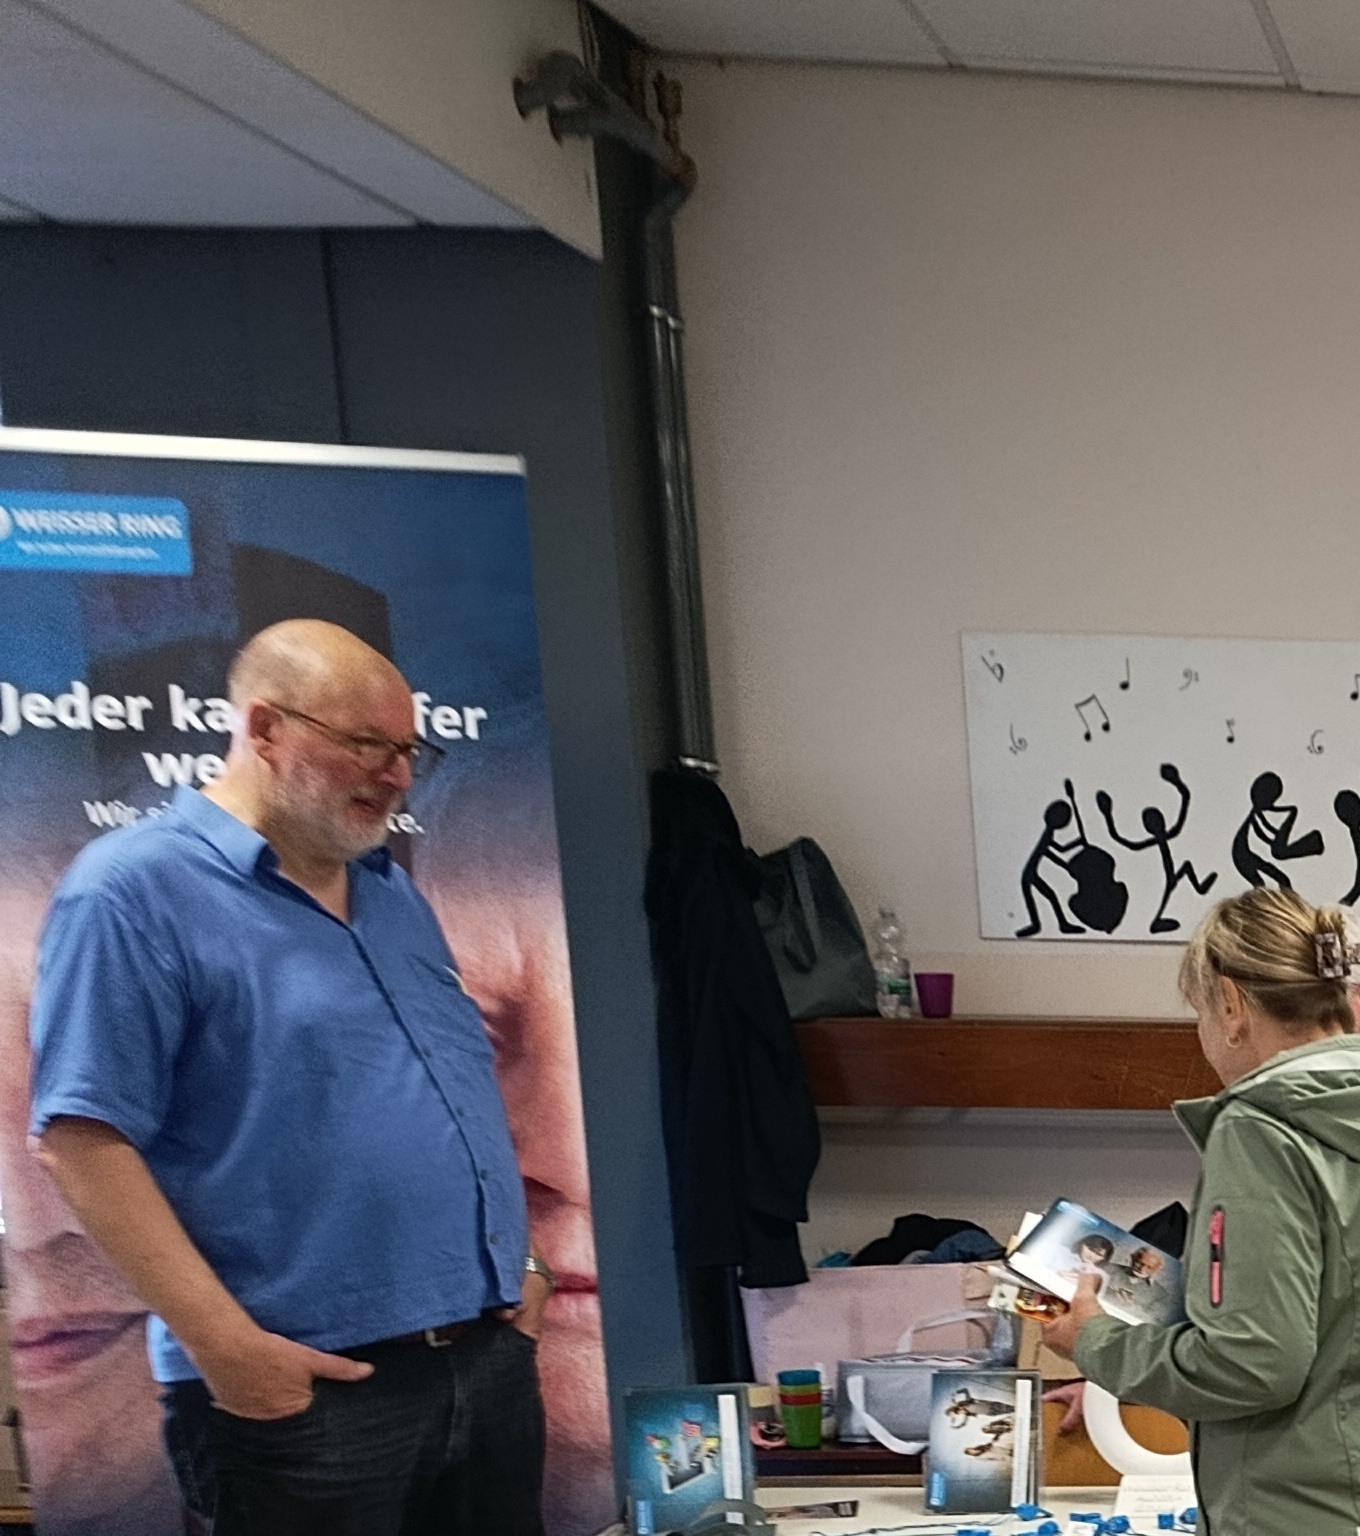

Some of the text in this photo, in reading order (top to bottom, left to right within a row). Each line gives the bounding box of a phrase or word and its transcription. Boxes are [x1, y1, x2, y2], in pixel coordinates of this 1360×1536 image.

[0, 681, 487, 741] Jeder ka fer
